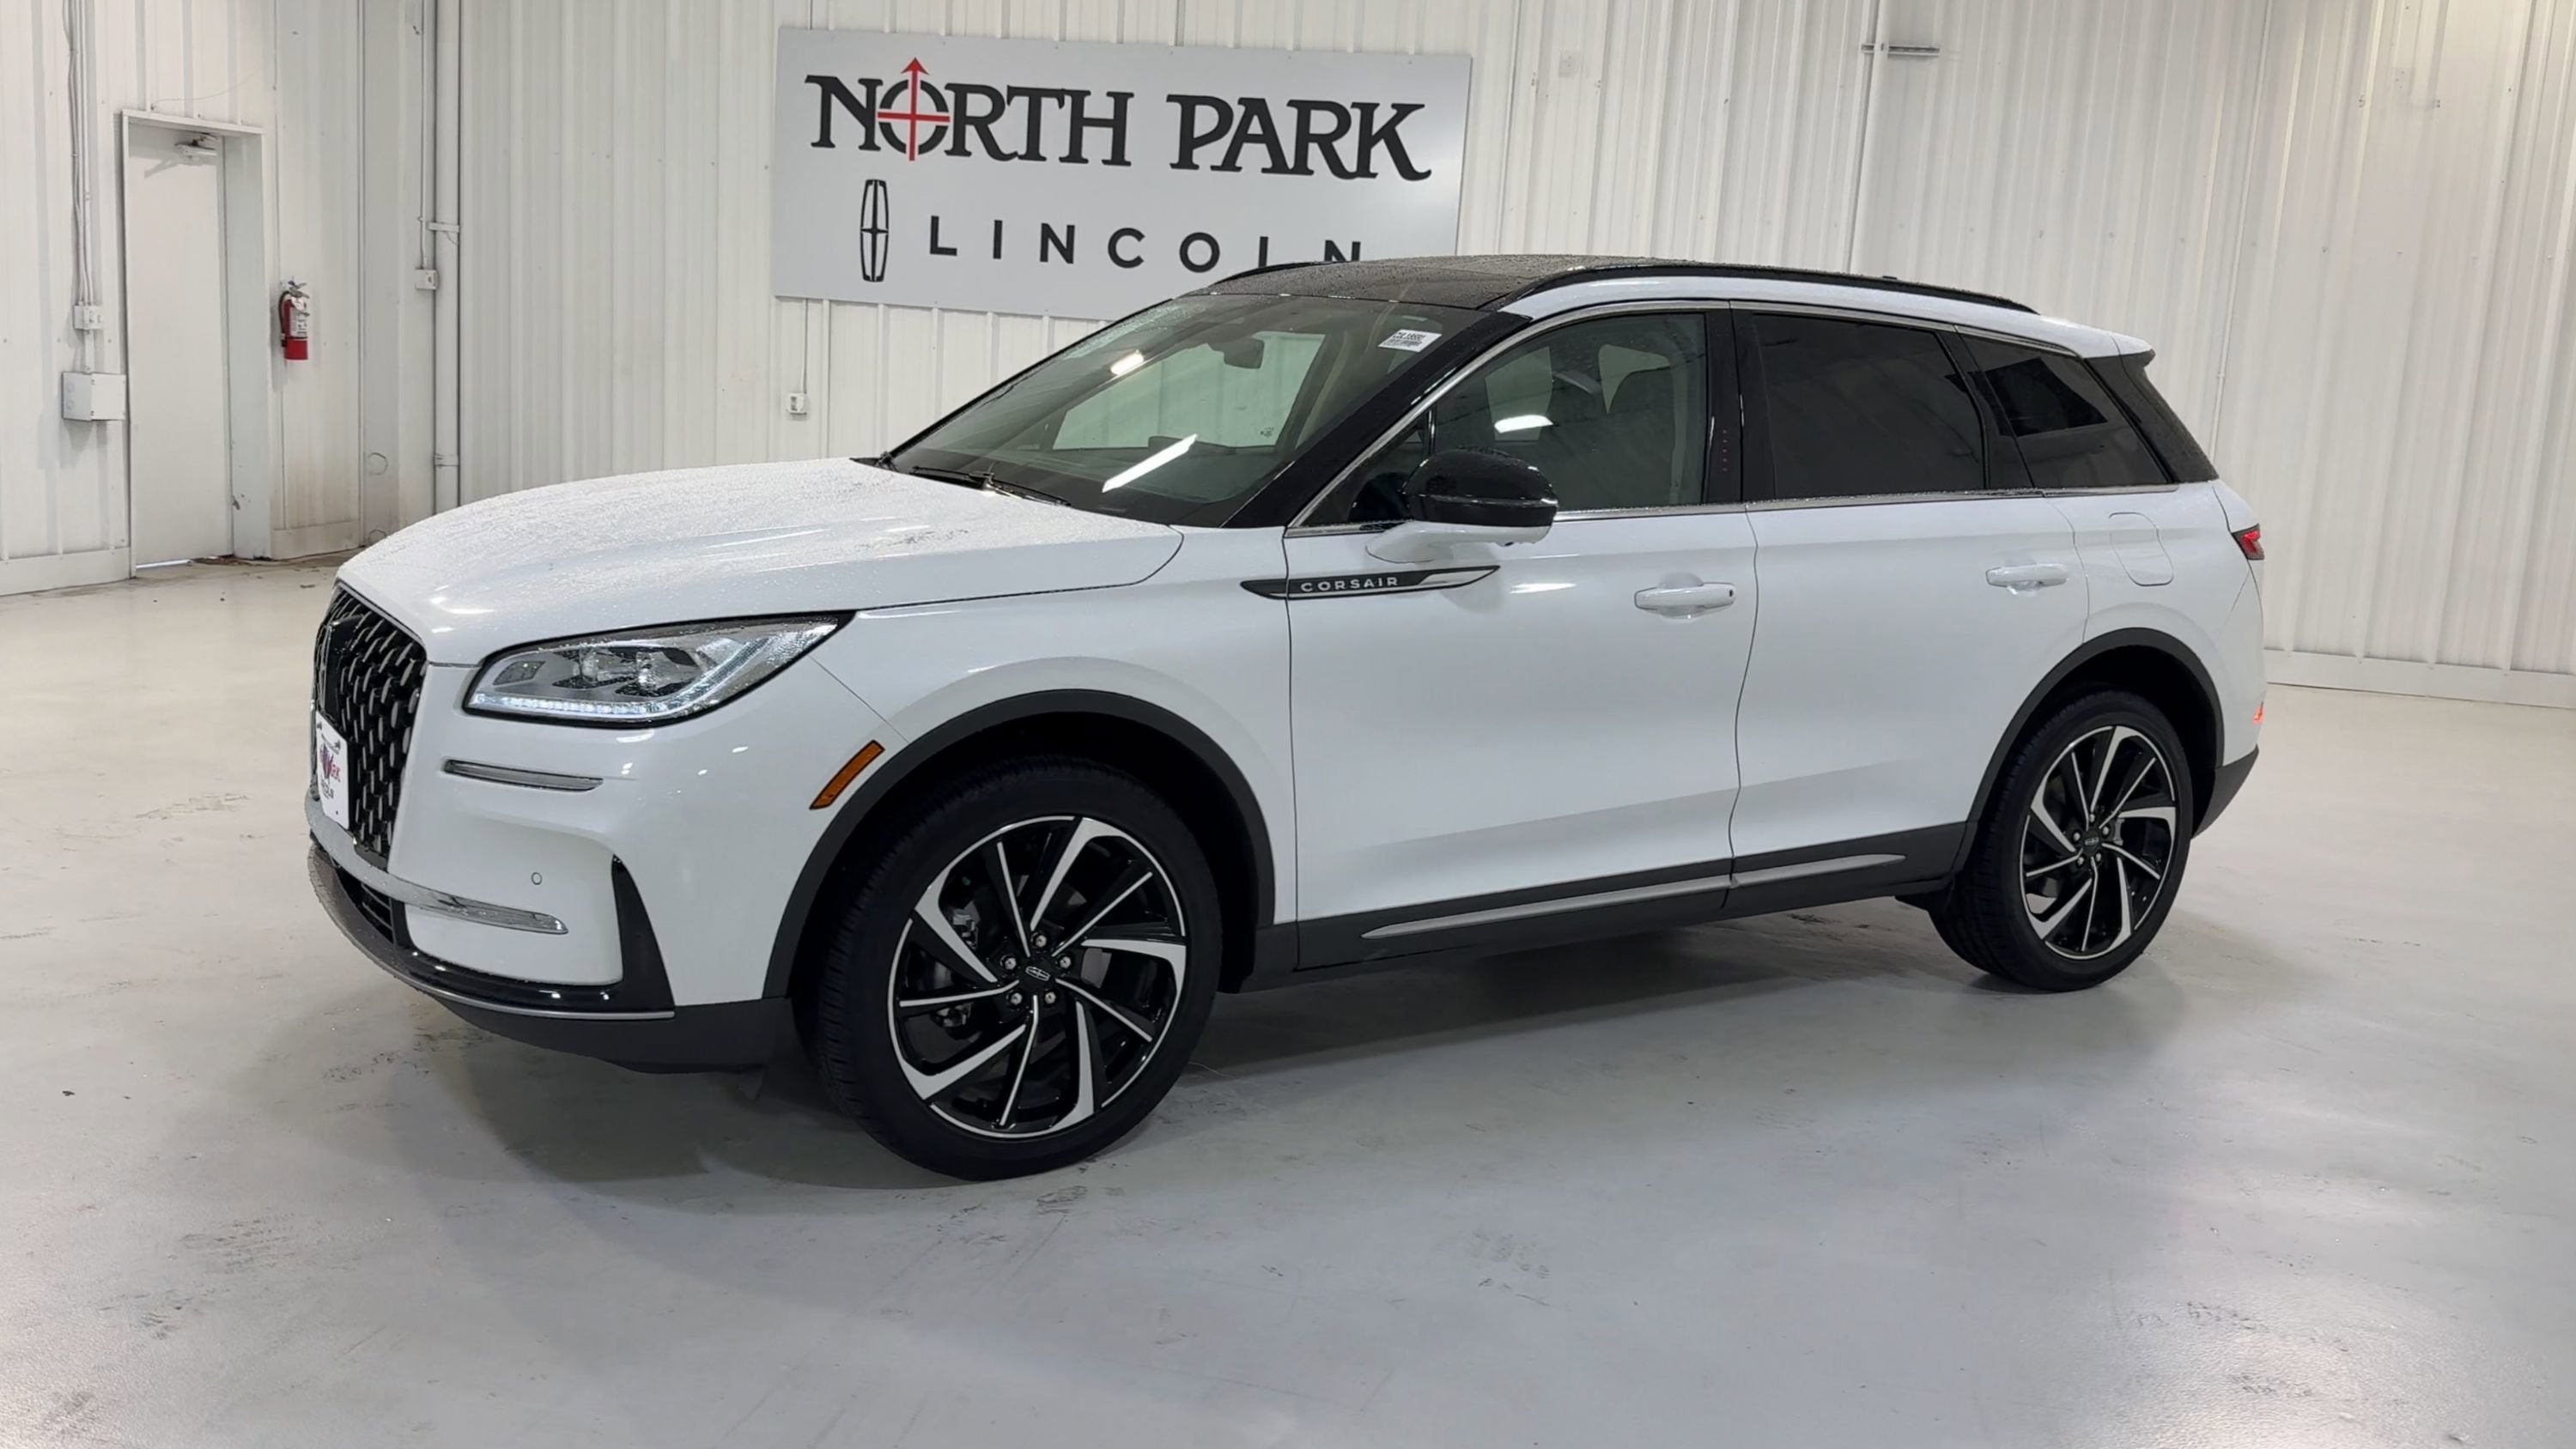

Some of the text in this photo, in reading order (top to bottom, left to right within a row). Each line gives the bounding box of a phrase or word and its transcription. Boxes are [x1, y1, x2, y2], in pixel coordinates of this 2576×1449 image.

[805, 74, 1431, 181] NORTH PARK
[1300, 576, 1398, 592] CORSAIR
